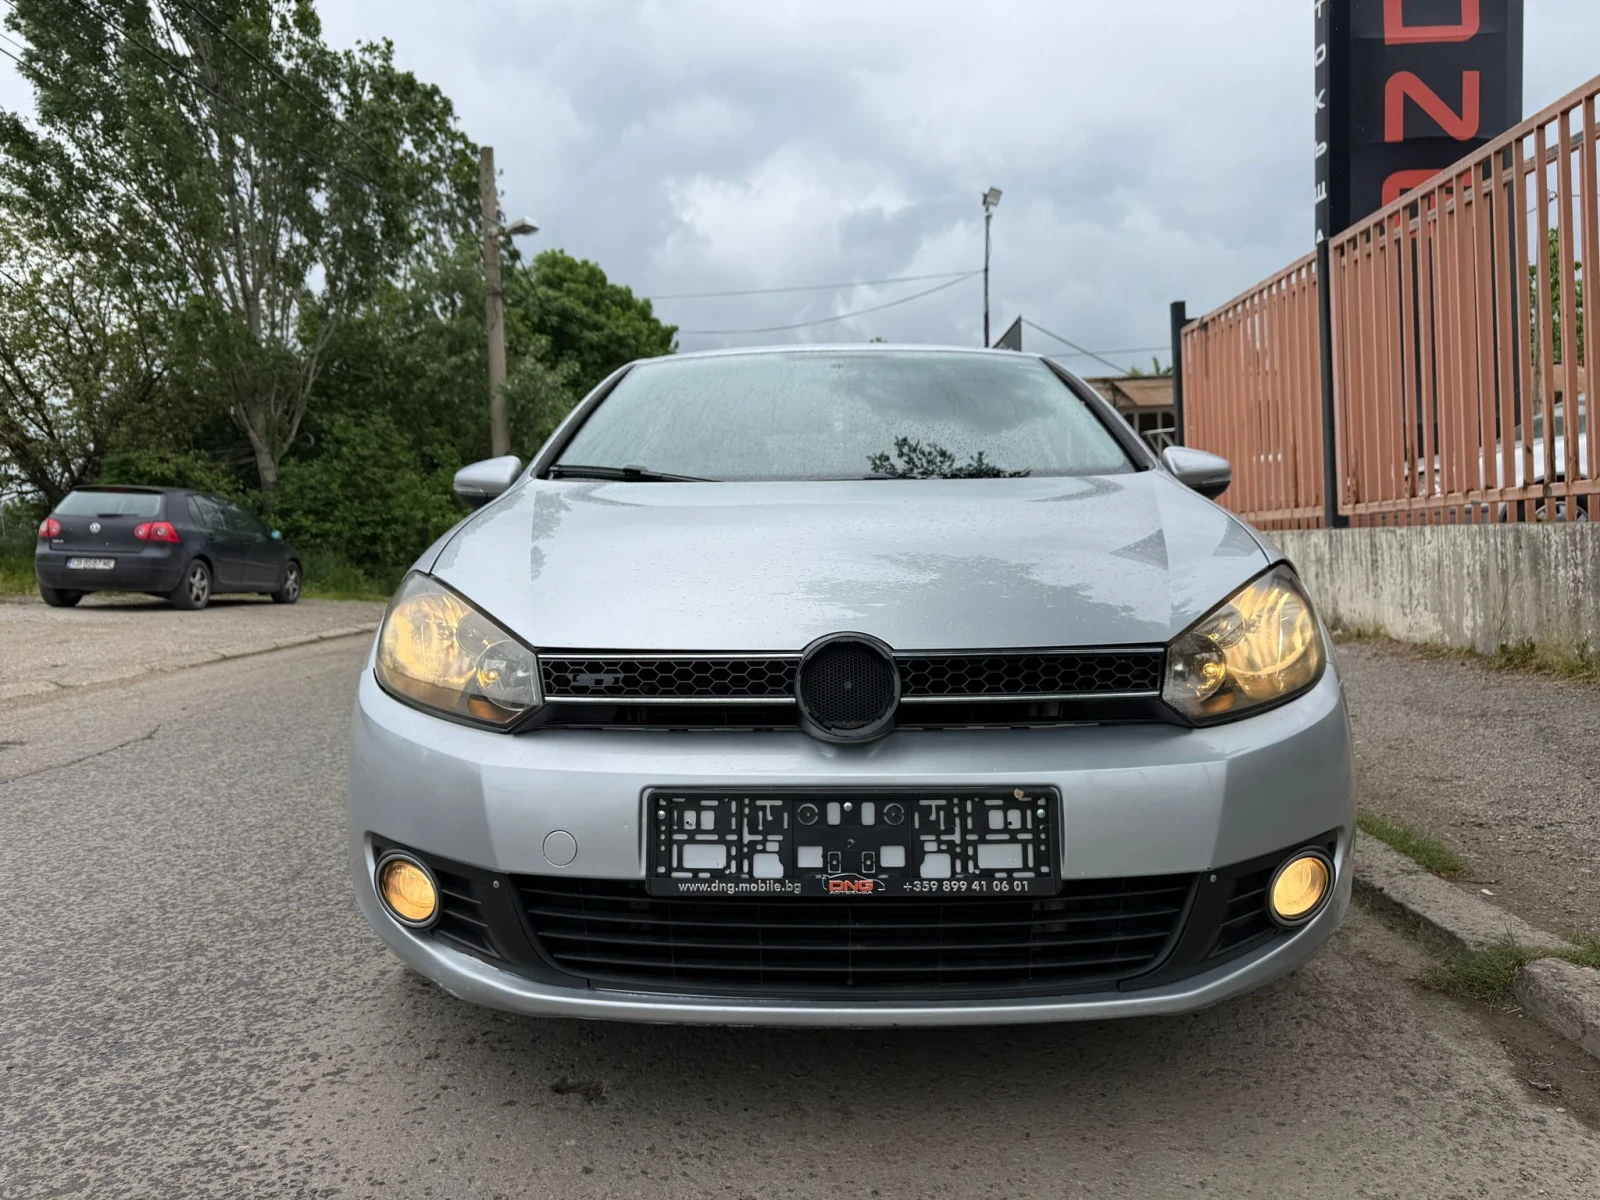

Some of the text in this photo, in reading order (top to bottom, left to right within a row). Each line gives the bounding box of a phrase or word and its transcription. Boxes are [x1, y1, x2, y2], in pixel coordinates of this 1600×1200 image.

[678, 879, 802, 894] www.dng.mobile.bg
[828, 879, 874, 891] DNG
[903, 880, 1029, 892] +359 899 41 06 01
